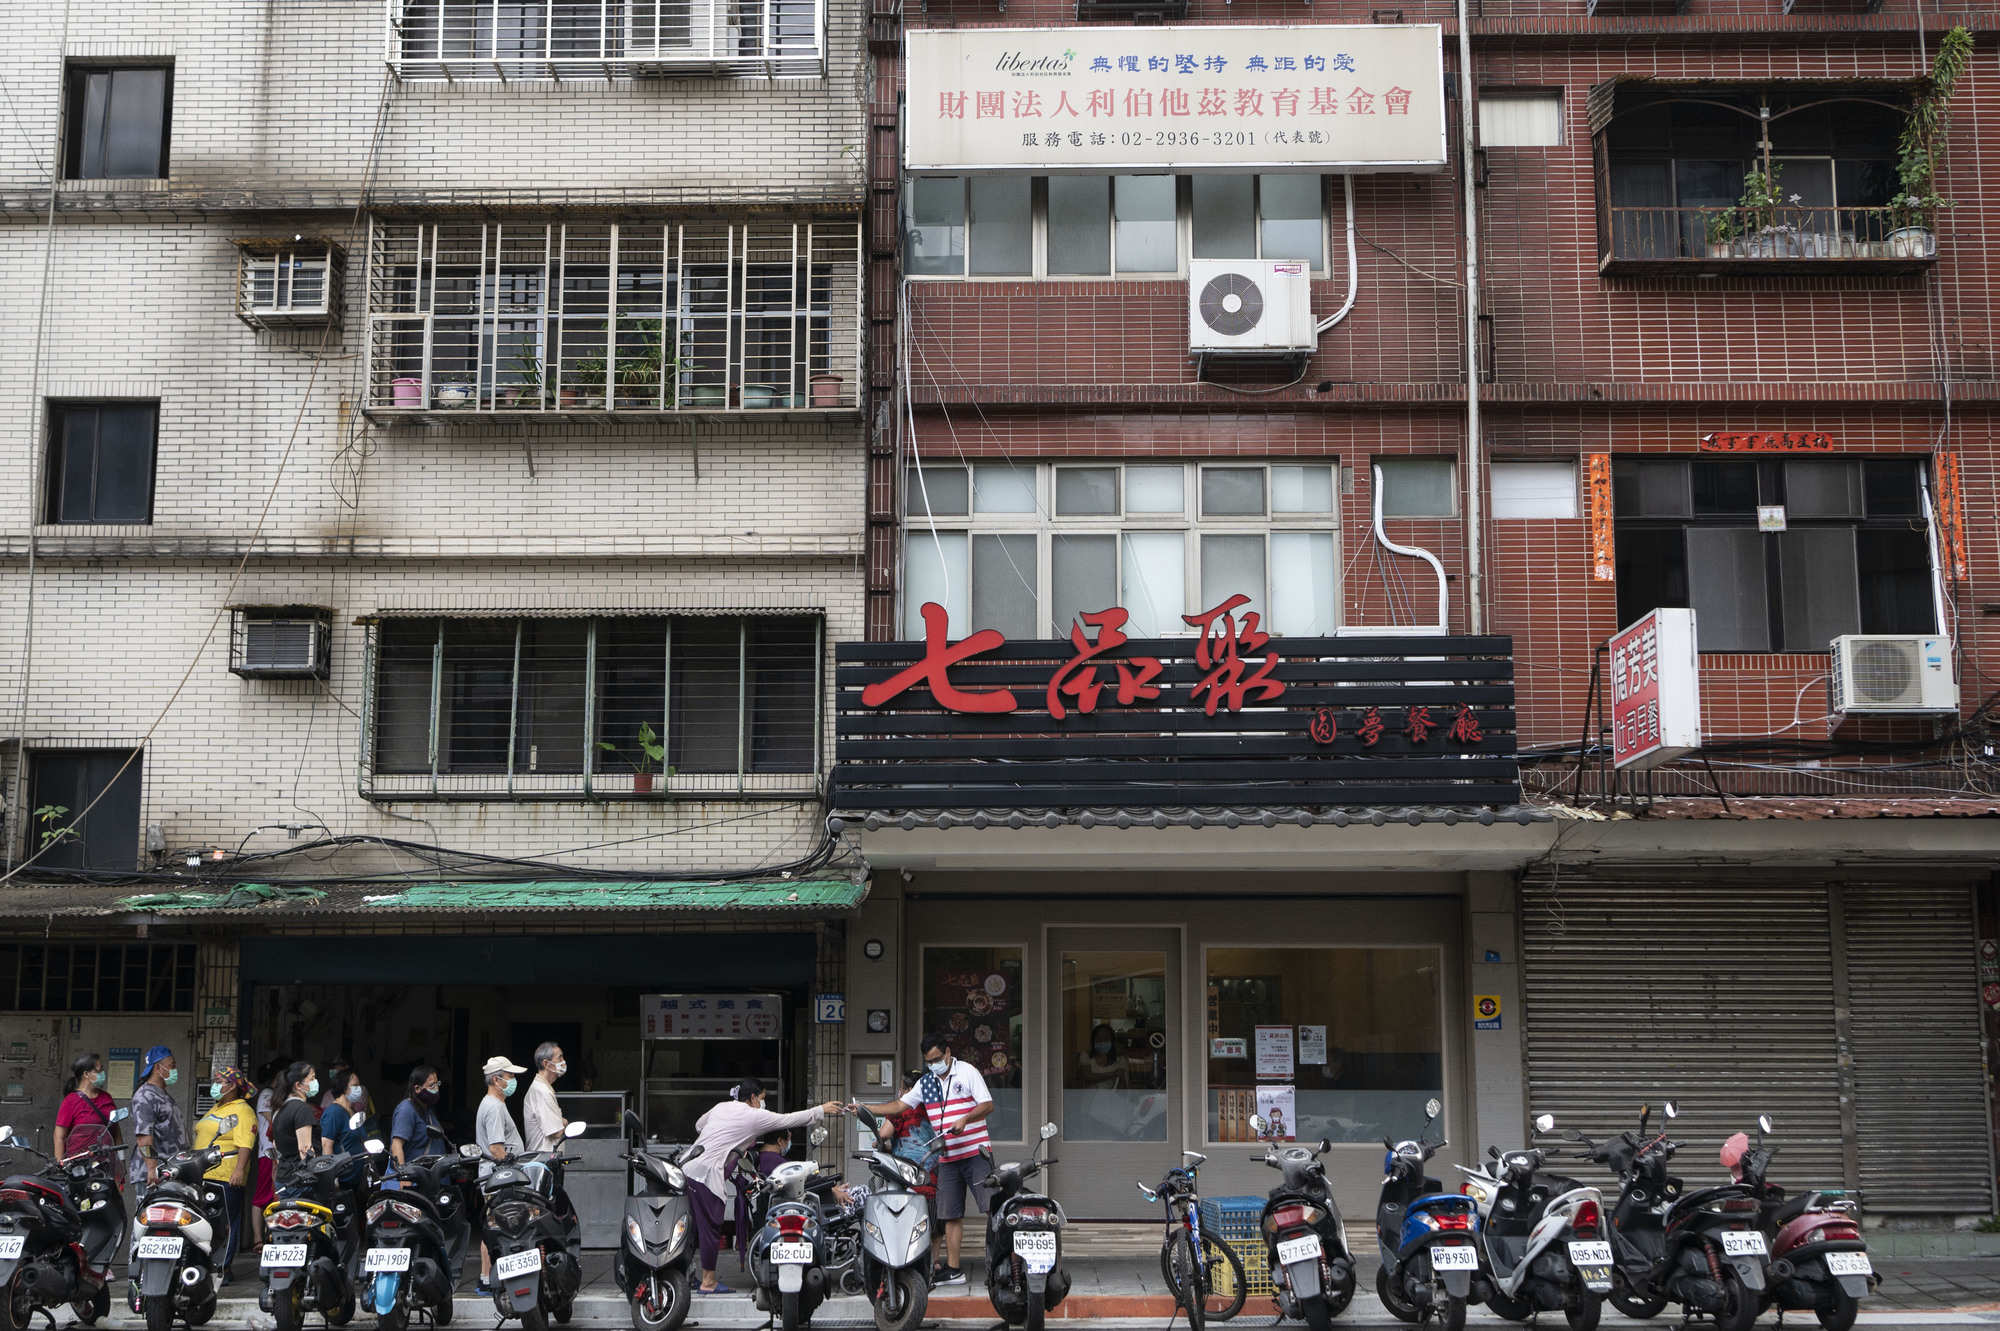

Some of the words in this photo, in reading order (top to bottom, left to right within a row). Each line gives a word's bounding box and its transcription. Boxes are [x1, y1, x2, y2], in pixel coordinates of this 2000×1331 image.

[996, 51, 1069, 72] libertas
[938, 85, 1414, 120] 財團法人利伯他茲教育基金會
[660, 999, 764, 1010] 越式美食
[209, 1016, 224, 1026] 20
